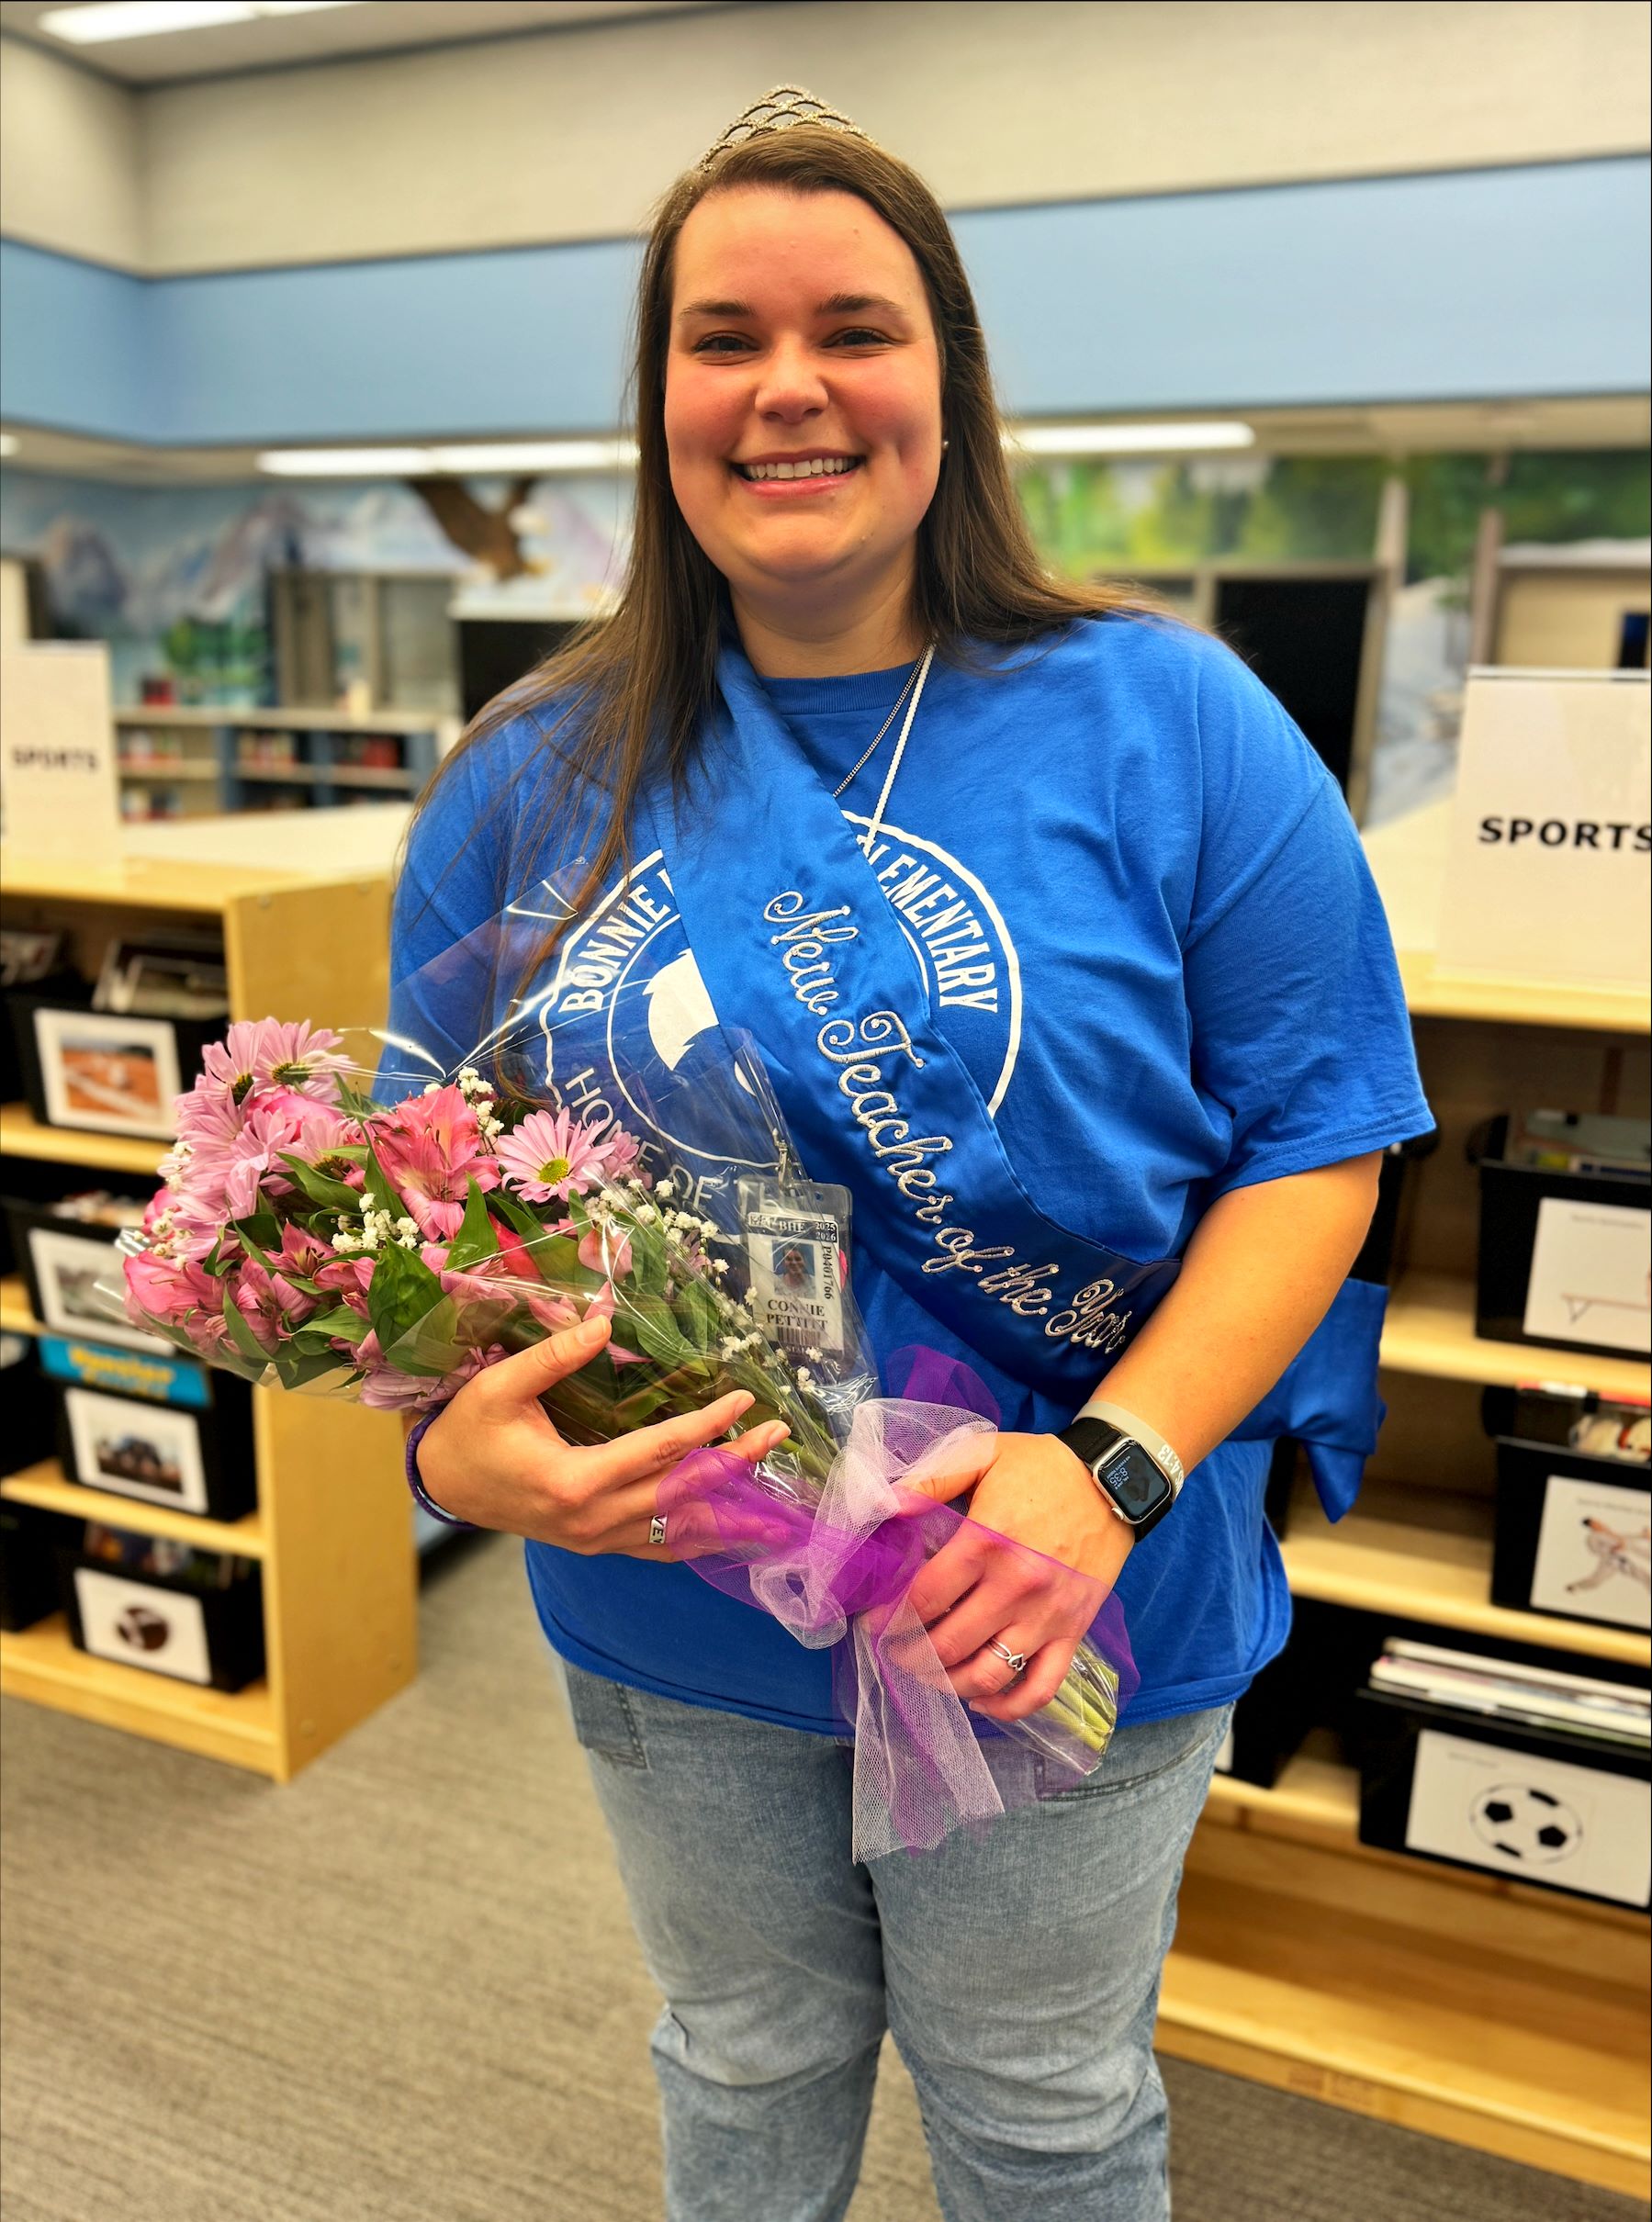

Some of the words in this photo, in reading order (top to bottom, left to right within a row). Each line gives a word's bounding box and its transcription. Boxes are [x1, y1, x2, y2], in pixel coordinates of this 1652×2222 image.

[11, 746, 99, 773] SPORTS
[1478, 814, 1651, 853] SPORTS
[558, 884, 671, 1013] BONNIE
[762, 890, 860, 1016] New
[816, 1010, 953, 1224] Teacher
[921, 1227, 1016, 1274] of
[977, 1262, 1060, 1316] the
[1045, 1279, 1132, 1354] Year
[779, 1219, 806, 1233] BHE
[815, 1222, 837, 1231] 2025
[815, 1231, 837, 1241] 2026
[822, 1245, 835, 1299] P0401766
[1108, 1467, 1129, 1487] 8:35
